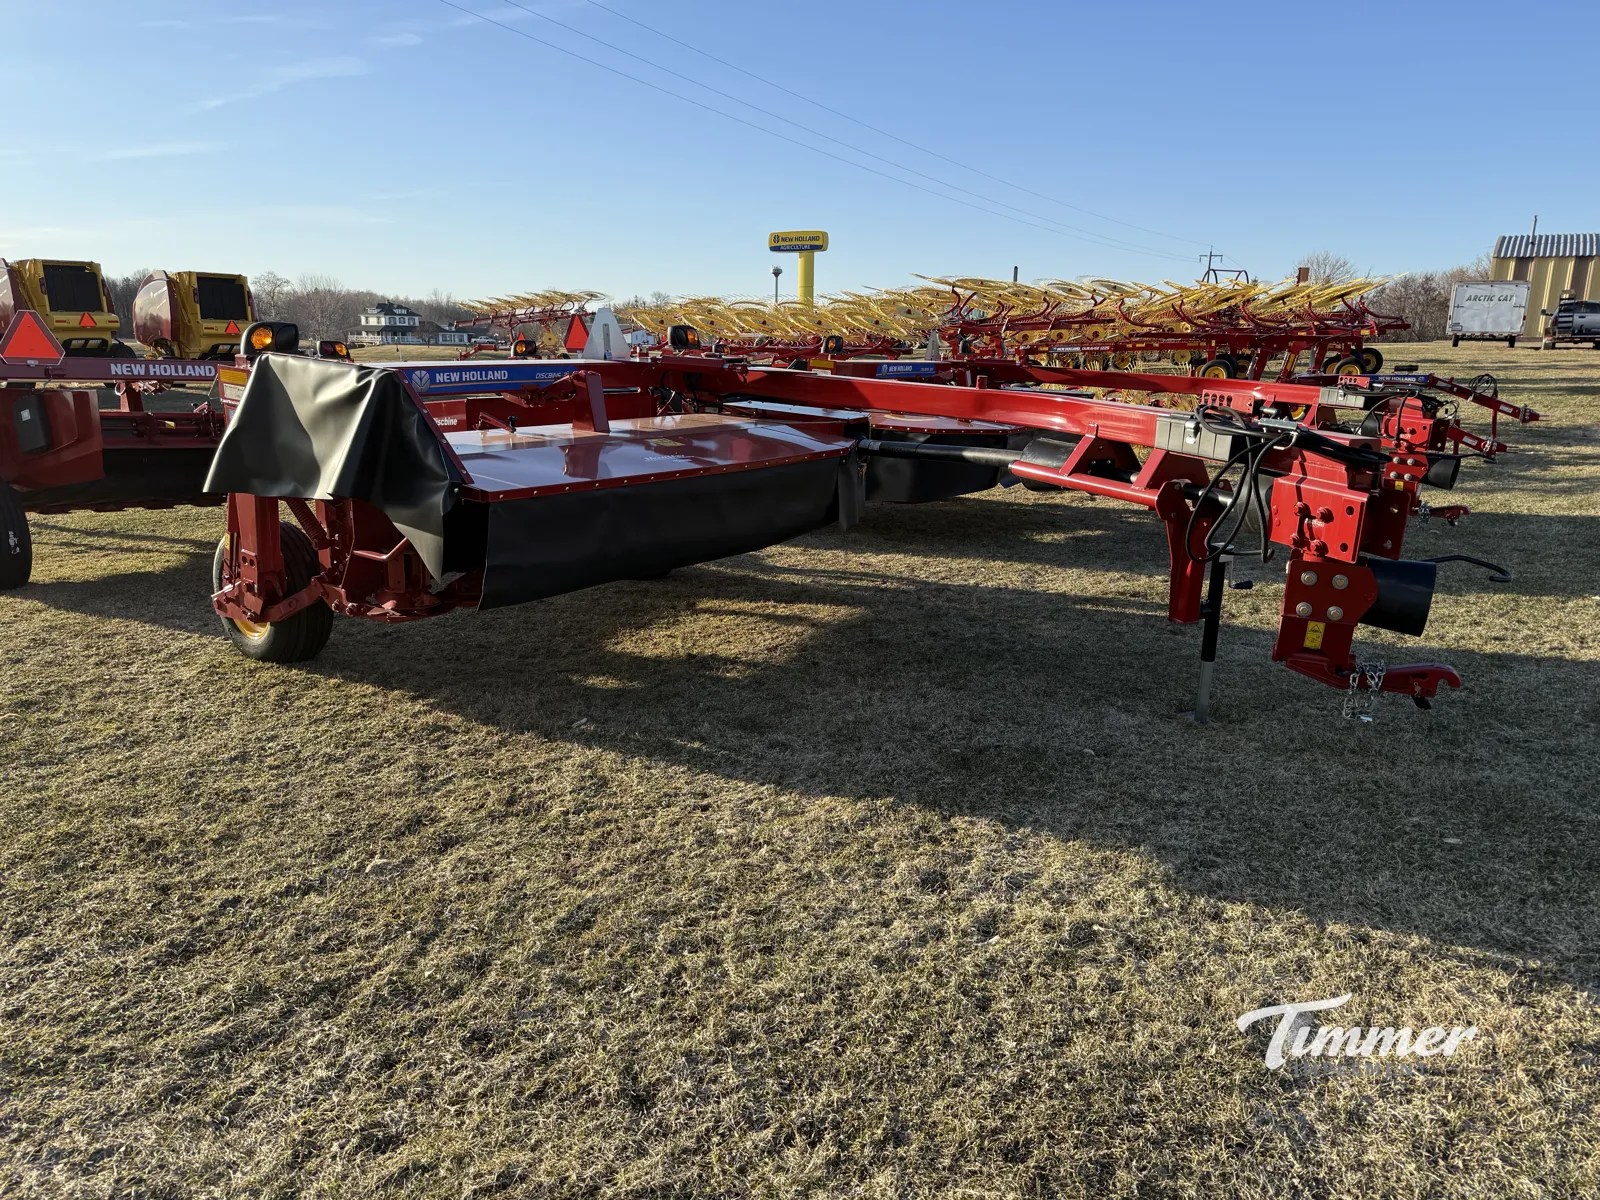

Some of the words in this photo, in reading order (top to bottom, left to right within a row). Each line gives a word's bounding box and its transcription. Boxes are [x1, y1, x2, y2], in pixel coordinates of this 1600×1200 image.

[1466, 294, 1495, 302] ARCTIC
[1497, 294, 1515, 302] CAT
[110, 363, 146, 375] NEW
[149, 364, 216, 377] HOLLAND
[435, 371, 460, 383] NEW
[462, 370, 508, 382] HOLLAND
